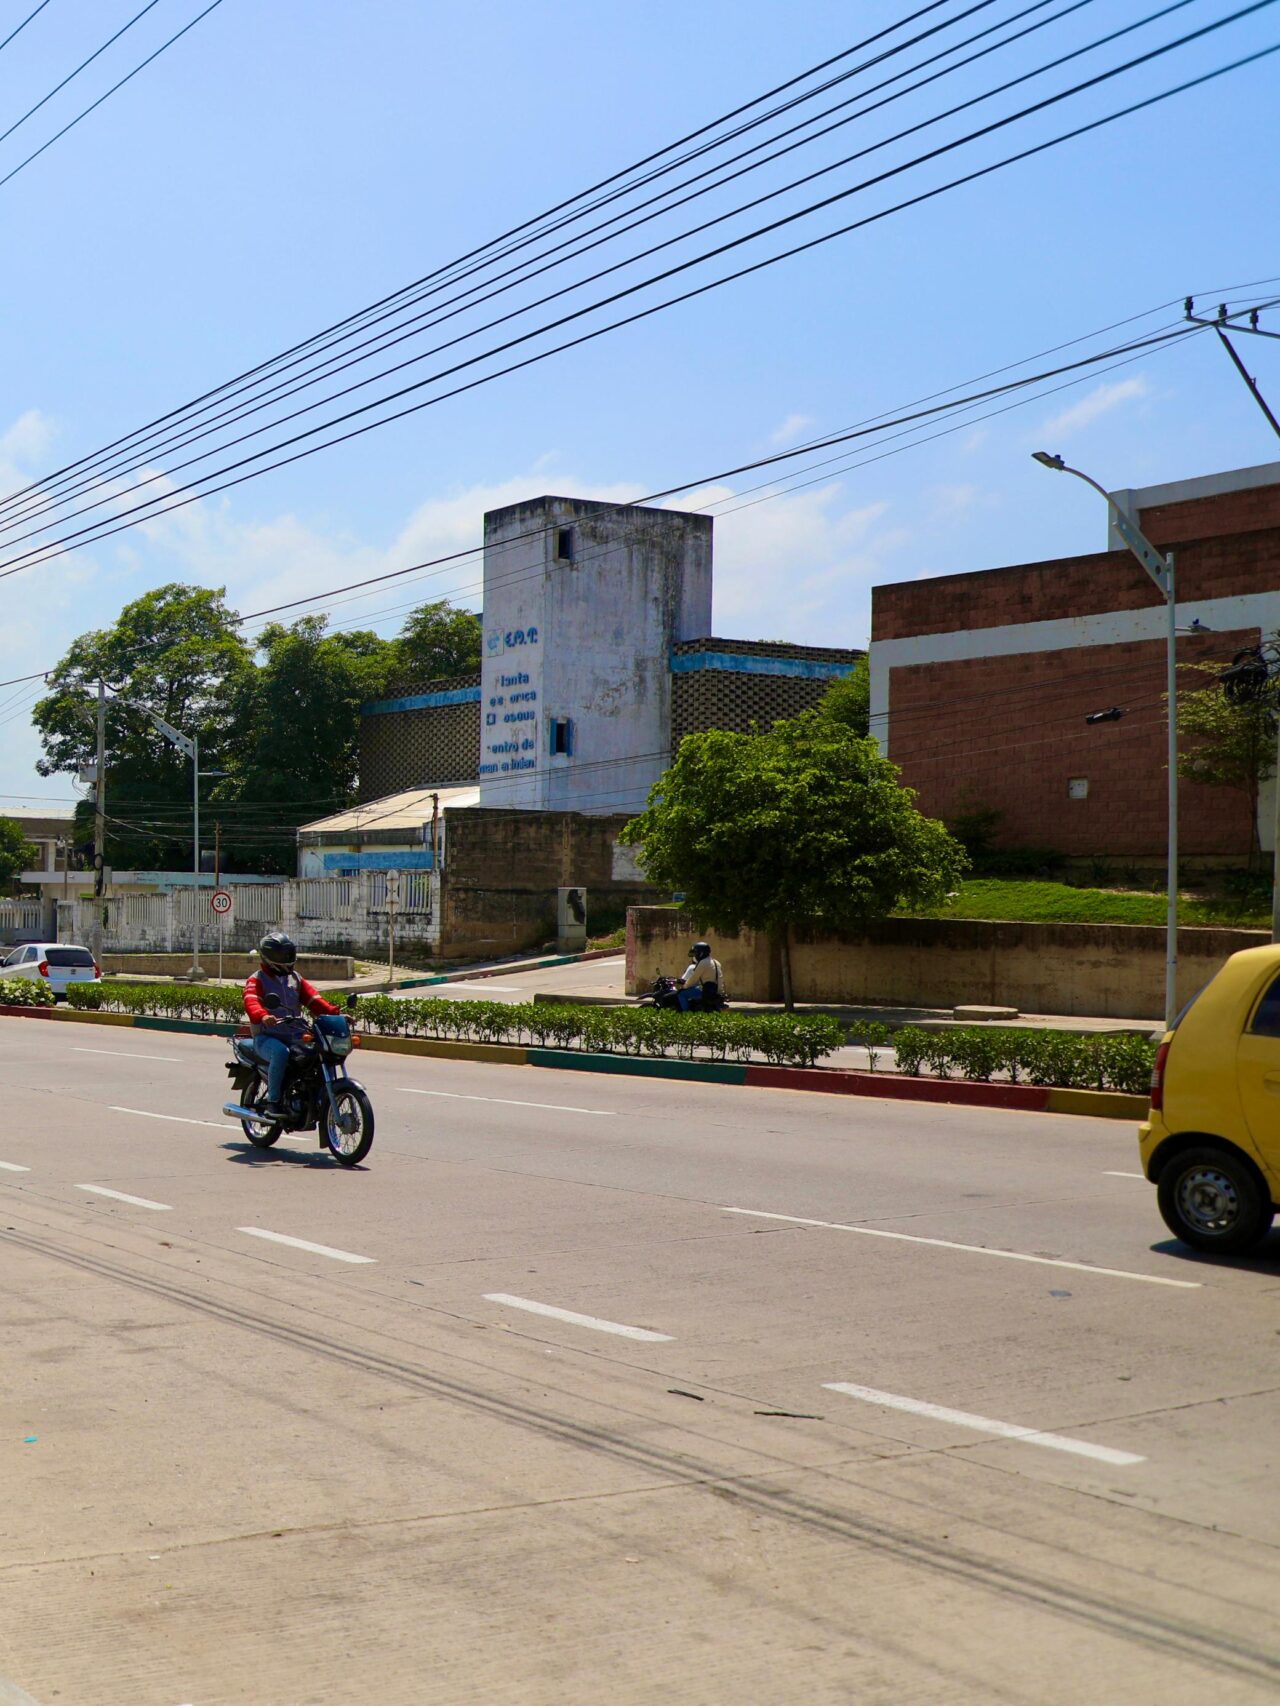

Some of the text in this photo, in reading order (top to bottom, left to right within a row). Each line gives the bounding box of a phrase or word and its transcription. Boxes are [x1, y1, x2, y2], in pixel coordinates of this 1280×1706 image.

[499, 672, 529, 687] lanta
[487, 740, 519, 755] entro
[216, 898, 228, 908] 30
